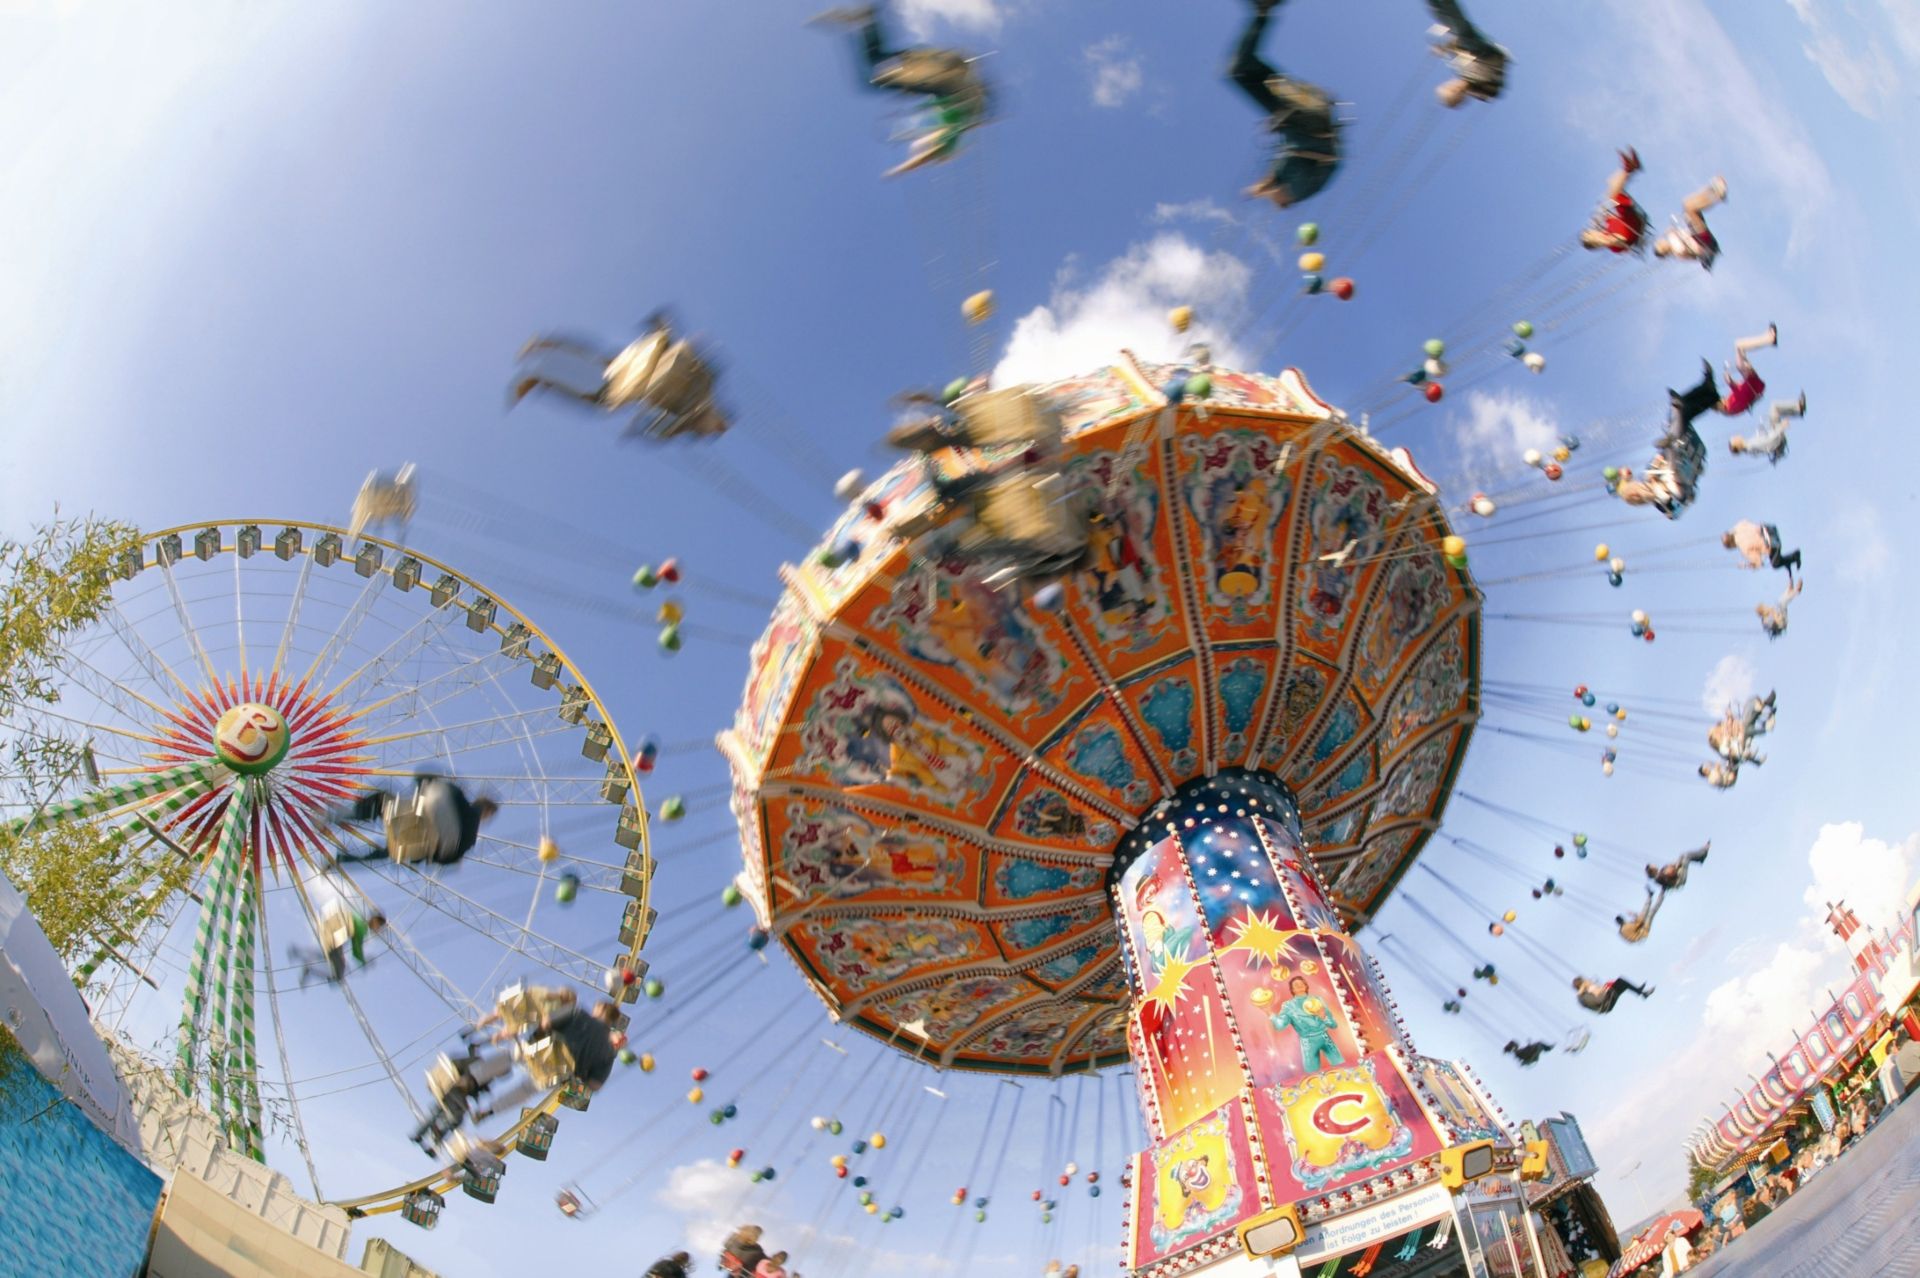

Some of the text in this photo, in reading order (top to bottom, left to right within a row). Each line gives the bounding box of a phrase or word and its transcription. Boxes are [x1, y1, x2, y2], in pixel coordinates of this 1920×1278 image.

[1313, 1094, 1371, 1135] C
[1319, 1216, 1376, 1241] Anordnungen
[1380, 1210, 1396, 1220] des
[1327, 1239, 1339, 1249] ist
[1341, 1231, 1367, 1244] Folge
[1370, 1226, 1380, 1235] zu
[1383, 1214, 1412, 1230] leisten
